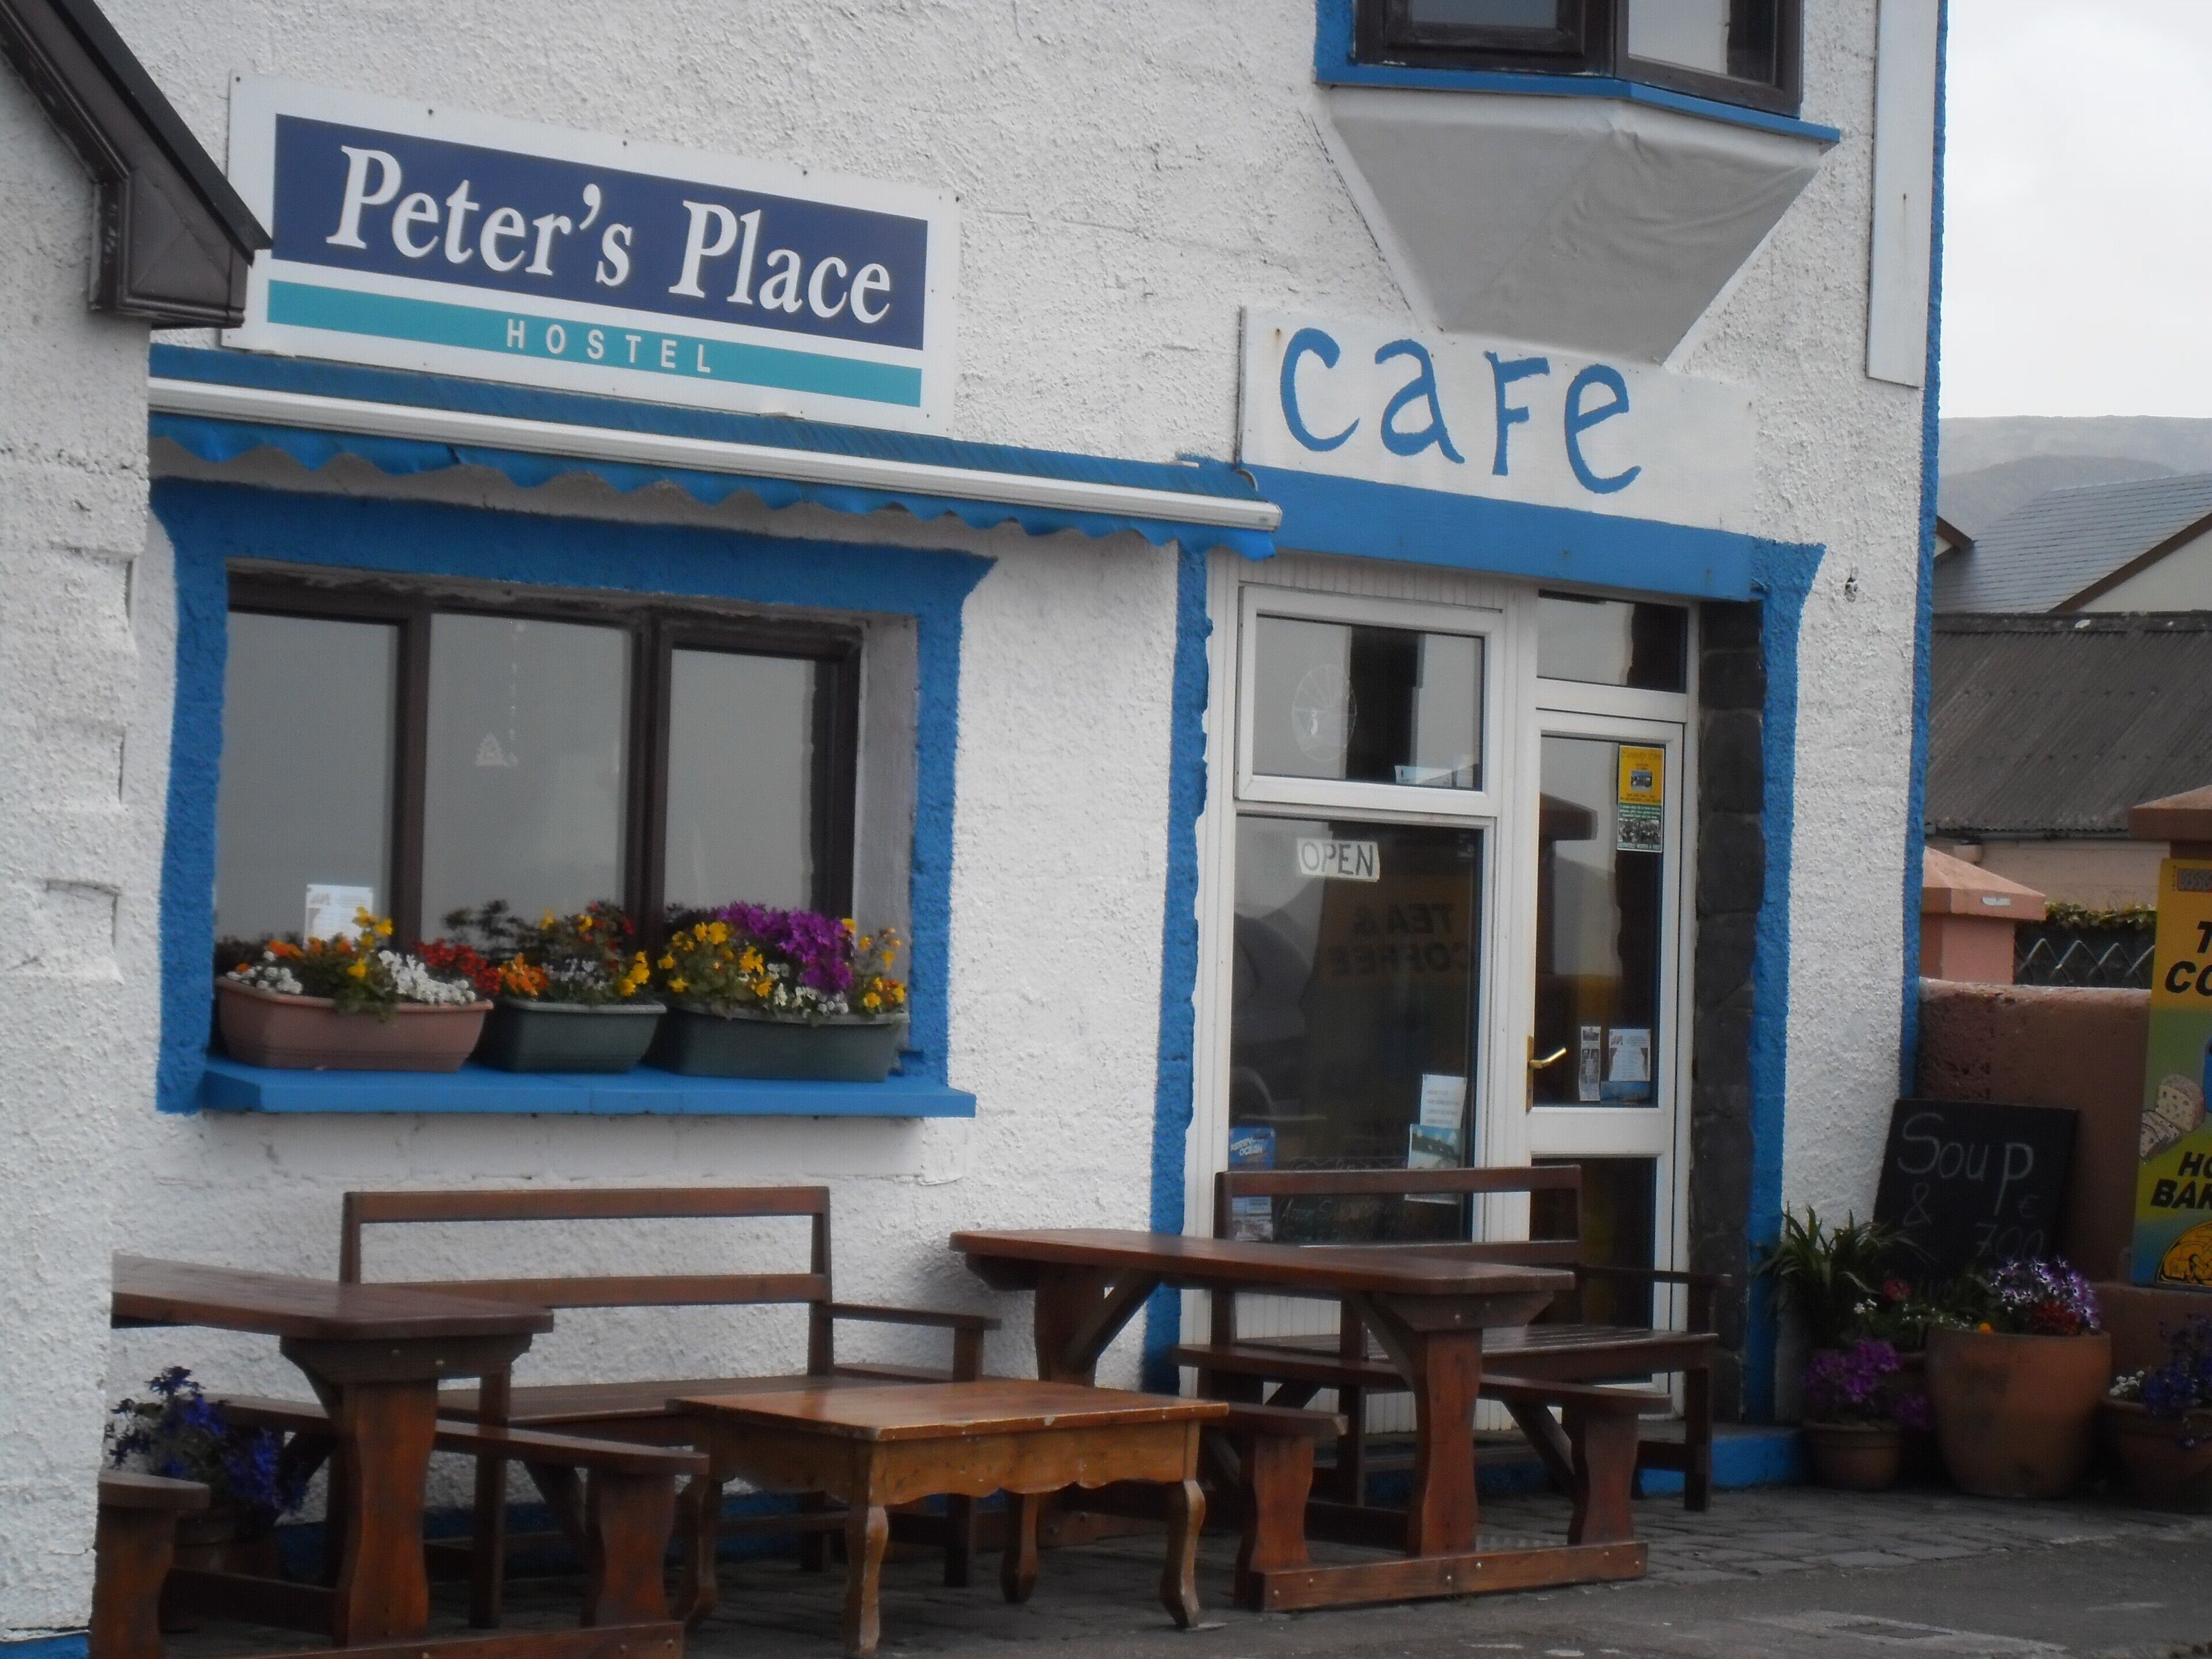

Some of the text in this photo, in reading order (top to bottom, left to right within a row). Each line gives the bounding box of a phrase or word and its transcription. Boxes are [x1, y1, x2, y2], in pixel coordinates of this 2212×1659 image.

[326, 145, 890, 324] Peter's Place
[506, 317, 712, 373] HOSTEL
[1301, 840, 1373, 877] OPEN
[1897, 1112, 2035, 1216] Soup
[1903, 1182, 1931, 1226] &
